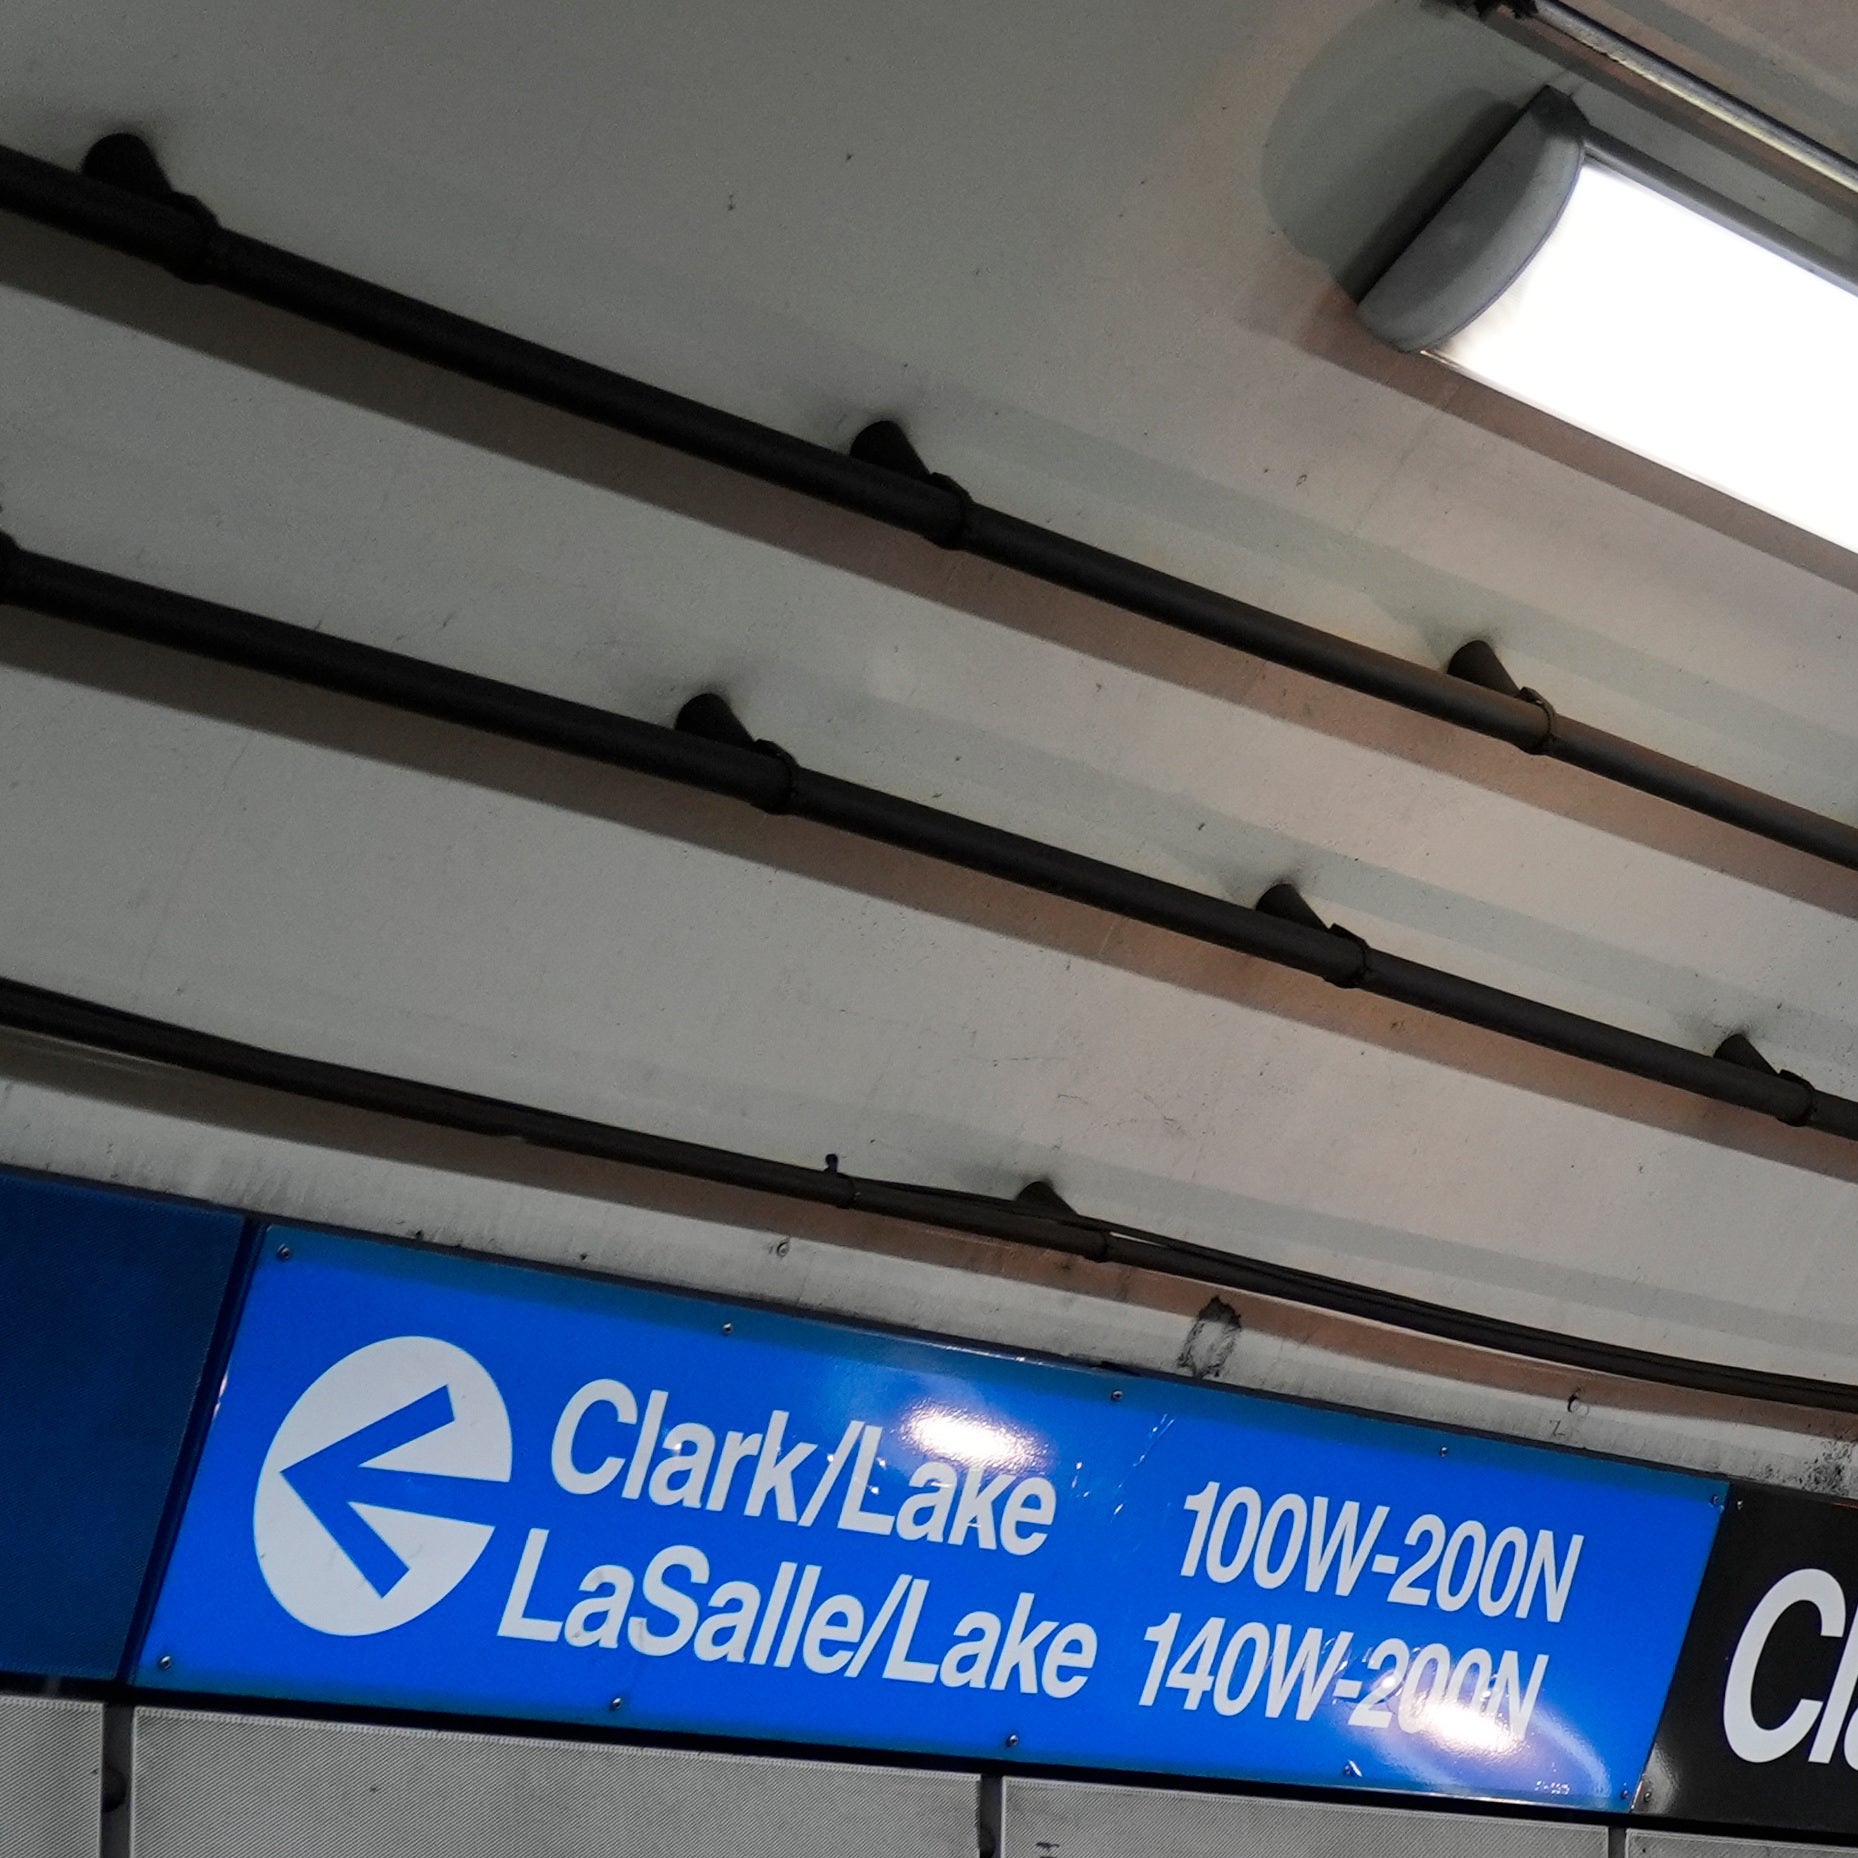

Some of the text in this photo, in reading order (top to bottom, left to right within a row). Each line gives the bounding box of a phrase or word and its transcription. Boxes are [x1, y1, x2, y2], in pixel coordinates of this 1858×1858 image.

[551, 1378, 1584, 1623] Clark/Lake 100W-200N
[497, 1528, 1549, 1741] LaSalle/Lake 140W-200N
